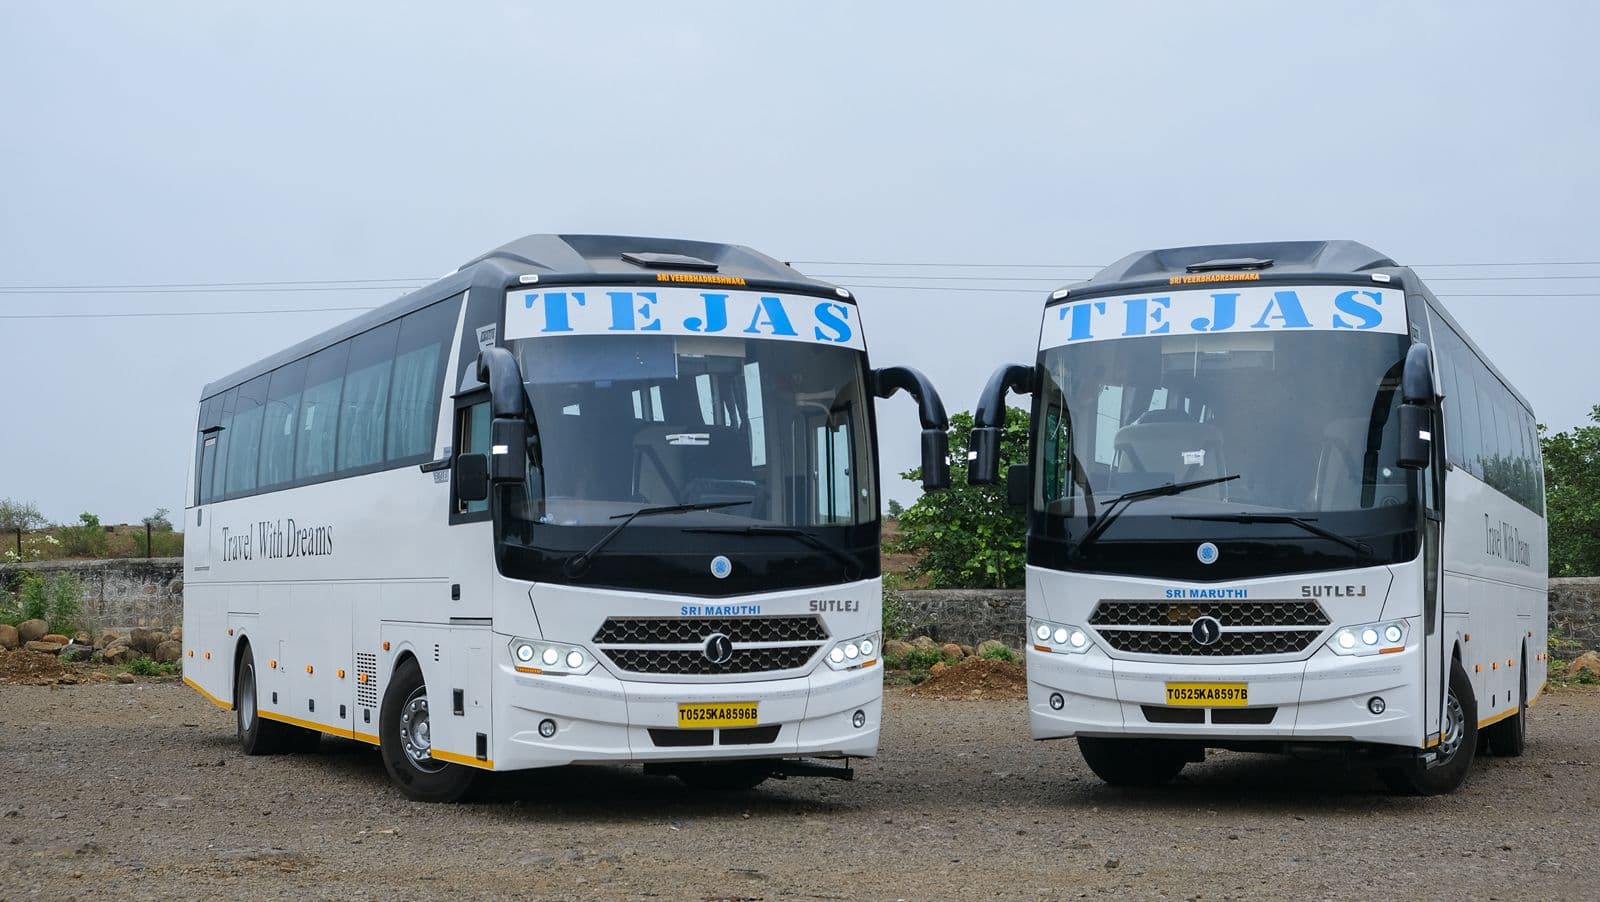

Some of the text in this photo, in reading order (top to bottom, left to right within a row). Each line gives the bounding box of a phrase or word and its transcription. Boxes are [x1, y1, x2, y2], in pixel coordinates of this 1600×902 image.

[1169, 276, 1182, 285] SRI
[525, 292, 852, 342] TEJAS
[1059, 291, 1383, 341] TEJAS
[222, 518, 333, 561] Travel With Dreams
[1166, 589, 1248, 599] SRI MARUTHI
[1301, 585, 1366, 598] SUTLEJ
[680, 605, 761, 616] SRI MARUTHI
[809, 600, 860, 612] SUTLEJ
